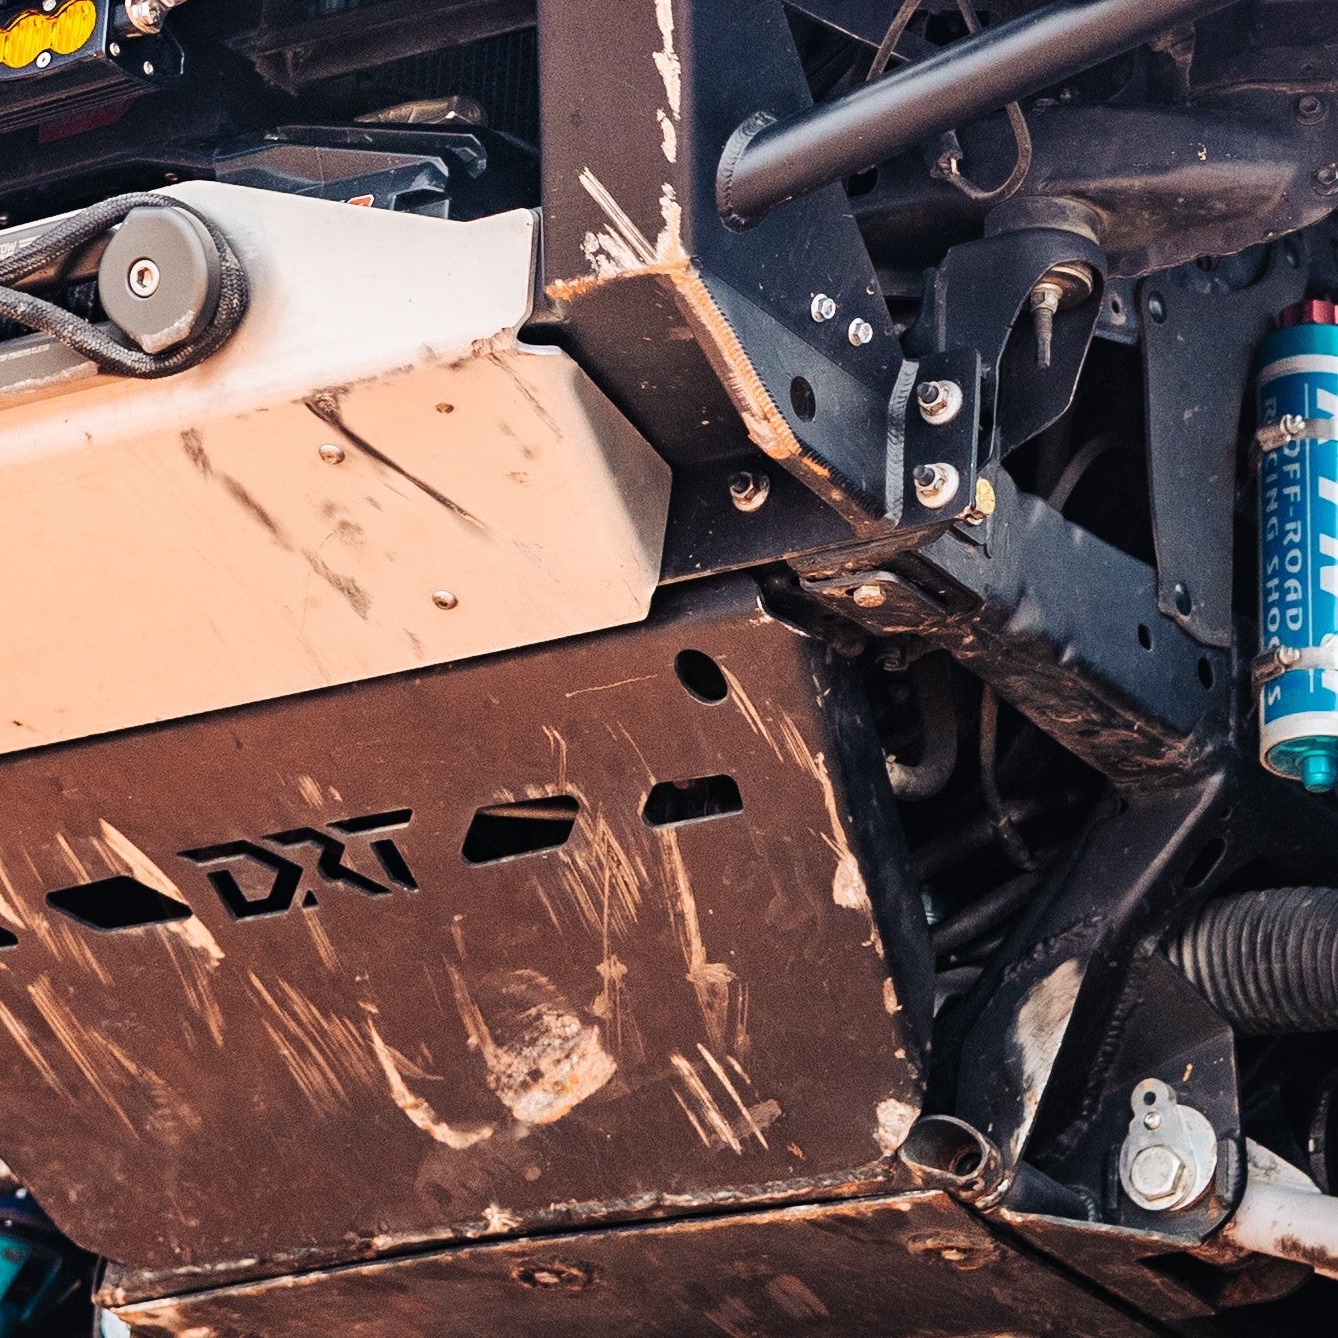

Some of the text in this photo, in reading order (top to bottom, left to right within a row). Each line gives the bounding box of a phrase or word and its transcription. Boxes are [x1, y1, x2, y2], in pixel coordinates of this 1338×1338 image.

[1265, 396, 1281, 706] RCING SHOCS
[1282, 438, 1303, 631] OFF-ROAD
[177, 808, 419, 920] DRT
